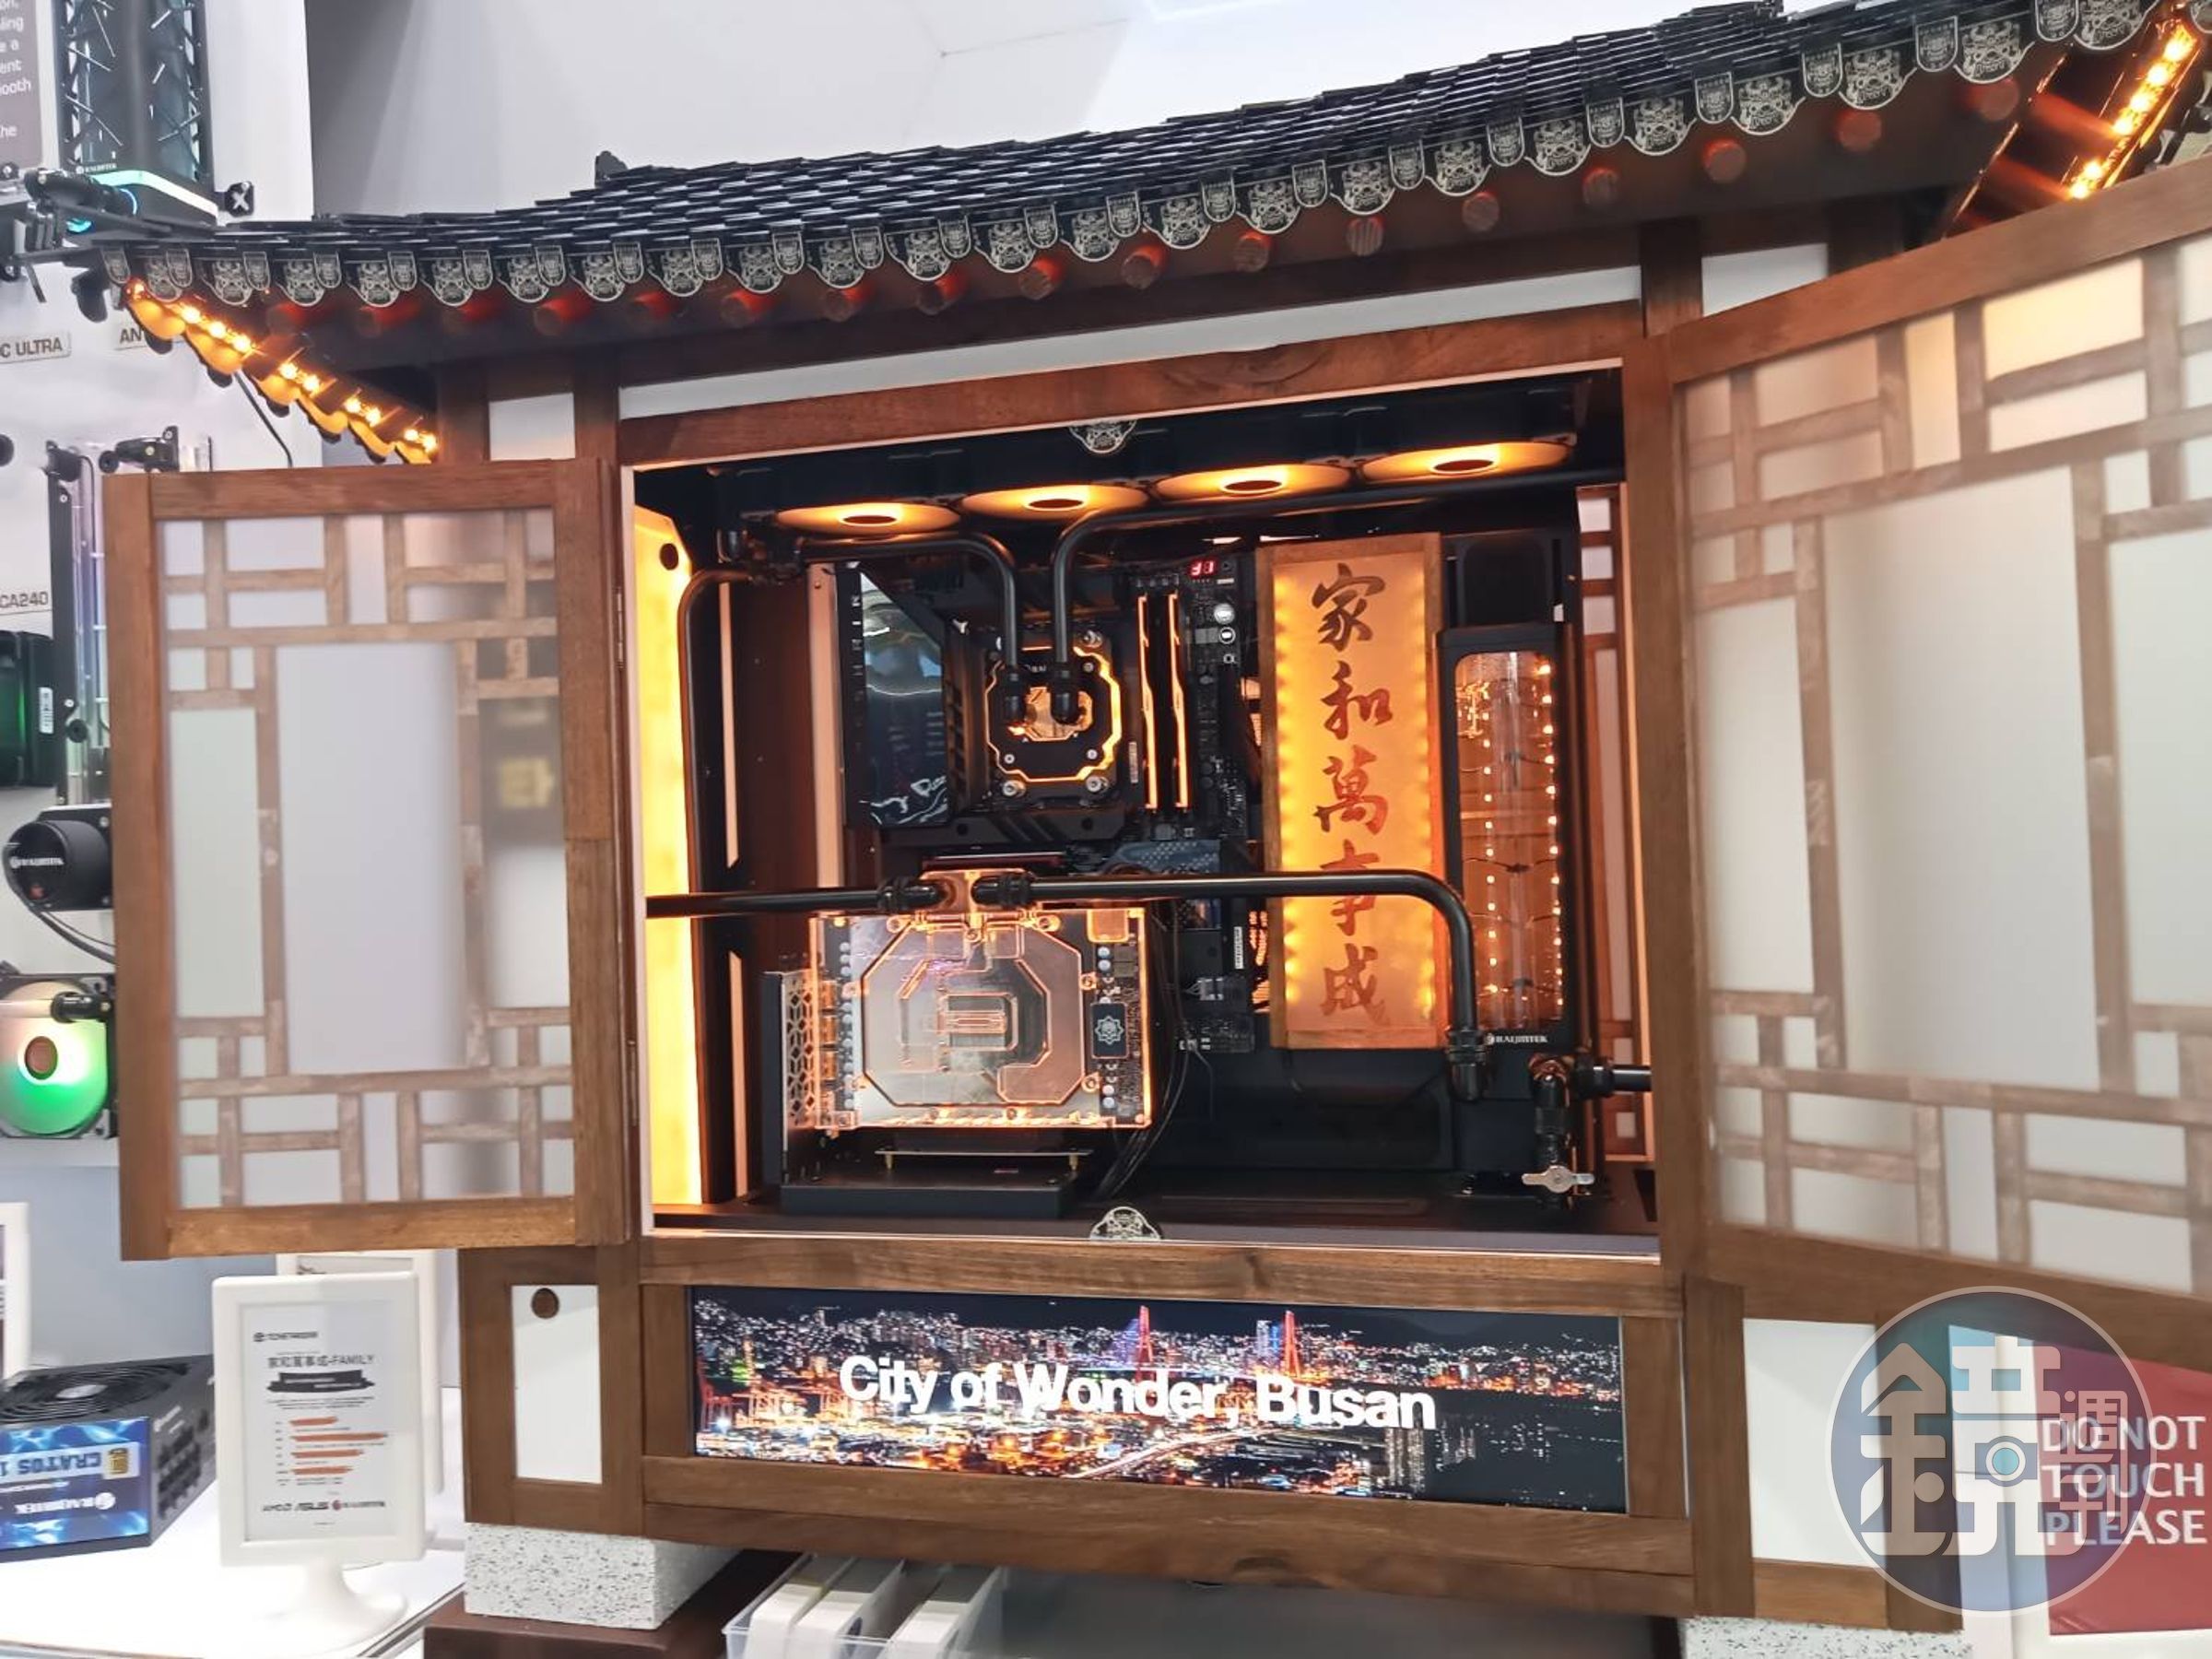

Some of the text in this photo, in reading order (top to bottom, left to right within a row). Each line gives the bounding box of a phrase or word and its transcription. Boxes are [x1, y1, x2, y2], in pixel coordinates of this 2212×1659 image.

[0, 77, 31, 94] ooth
[16, 337, 63, 356] ULTRA
[839, 1355, 1437, 1430] City of Wonder, Busan
[2041, 1415, 2206, 1453] DO NOT
[2041, 1462, 2205, 1500] TOUCH
[2045, 1510, 2208, 1547] PLEASE
